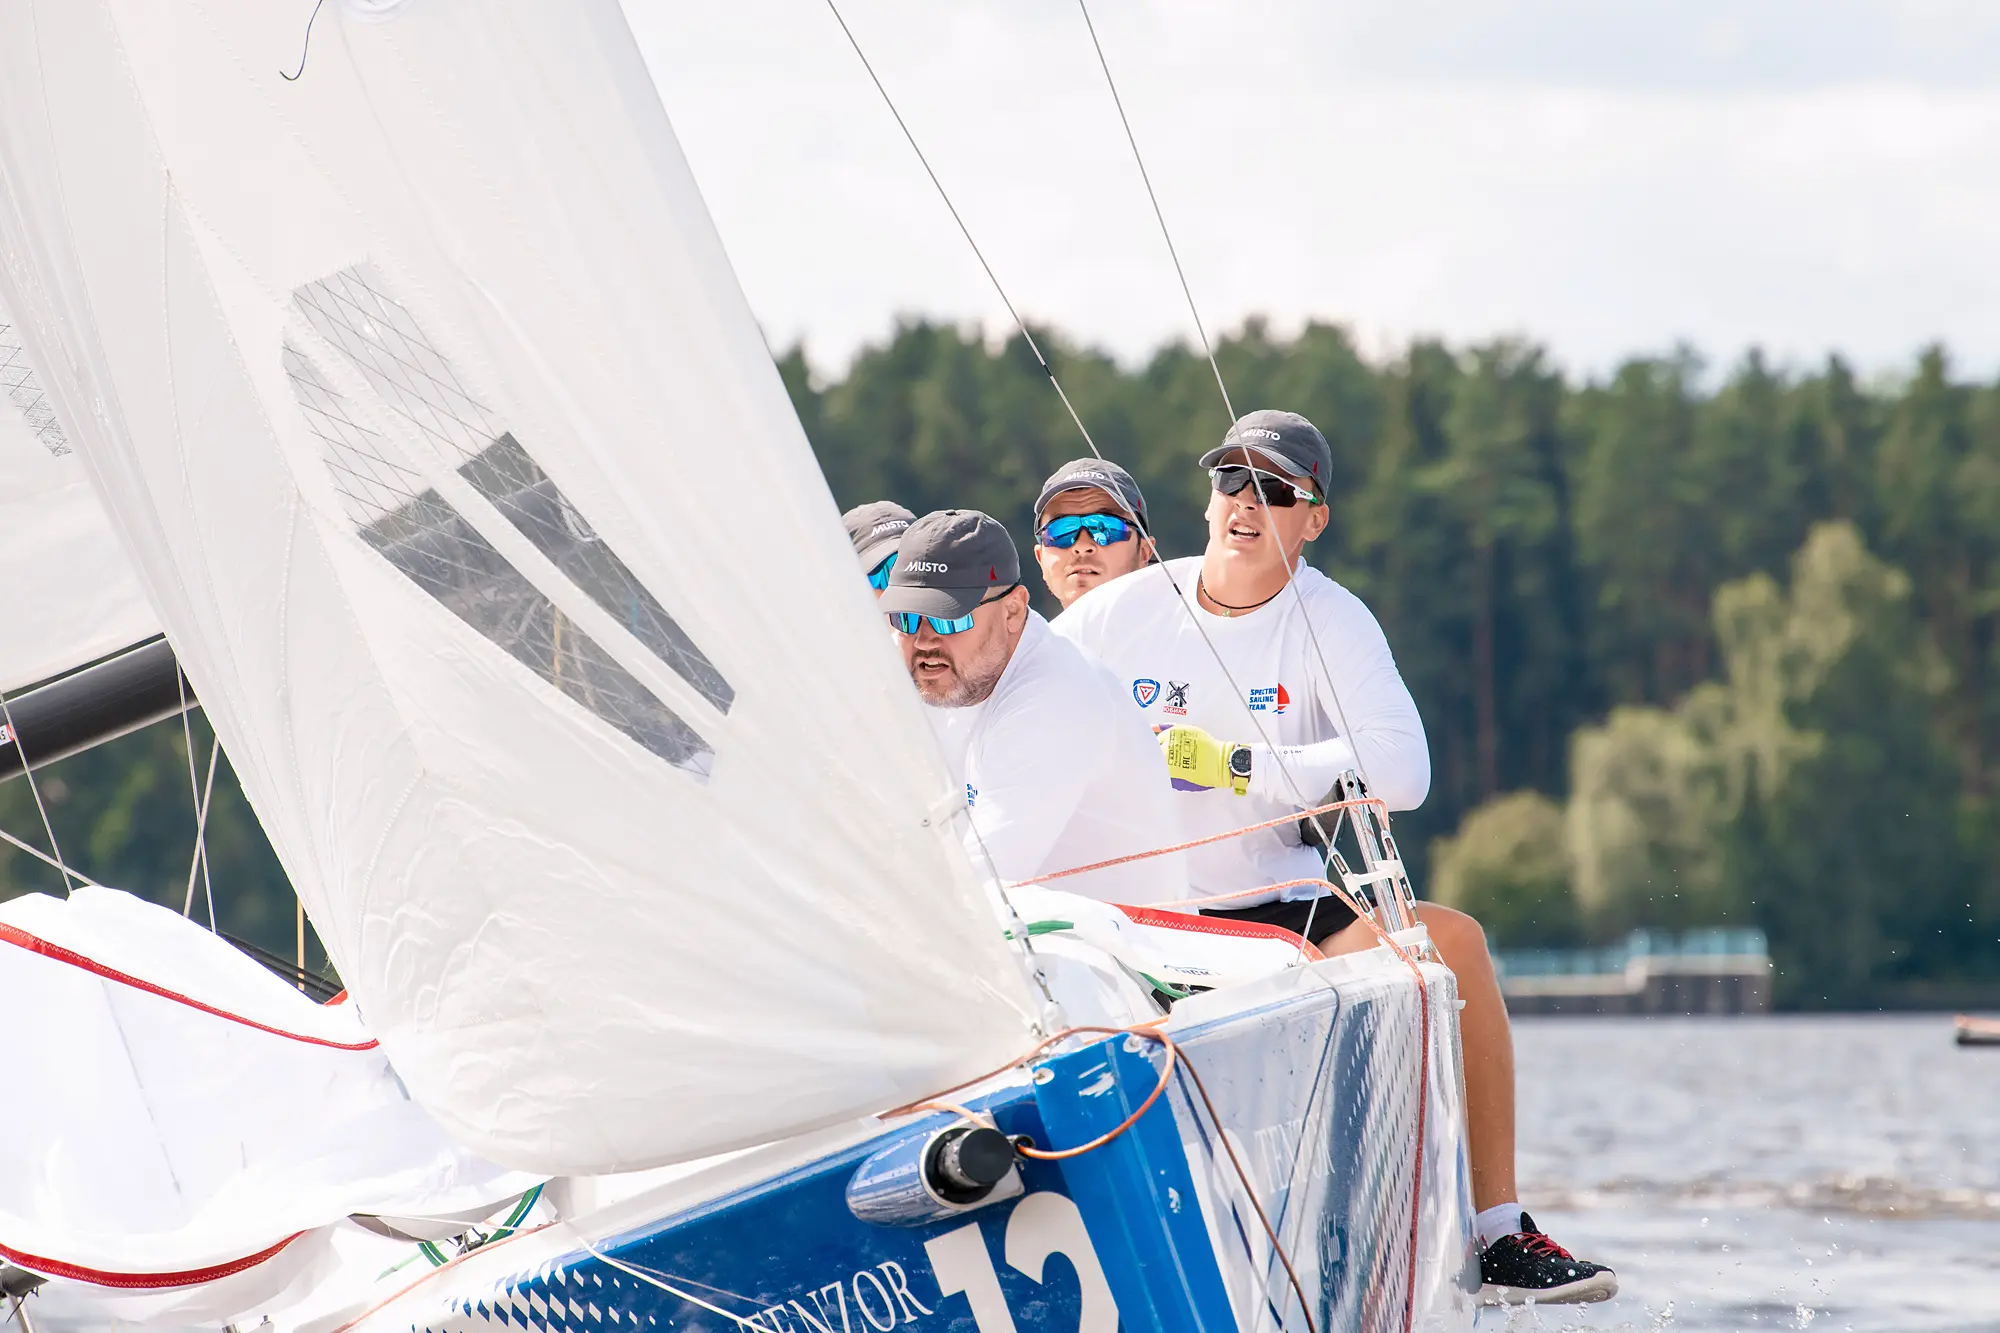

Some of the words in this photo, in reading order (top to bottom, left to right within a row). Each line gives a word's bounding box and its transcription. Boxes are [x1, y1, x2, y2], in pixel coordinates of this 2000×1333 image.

[1241, 428, 1281, 441] MUSTO
[1065, 470, 1105, 481] MUSTO
[871, 520, 910, 538] MUSTO
[904, 561, 948, 573] MUSTO
[1249, 695, 1275, 703] SAILING
